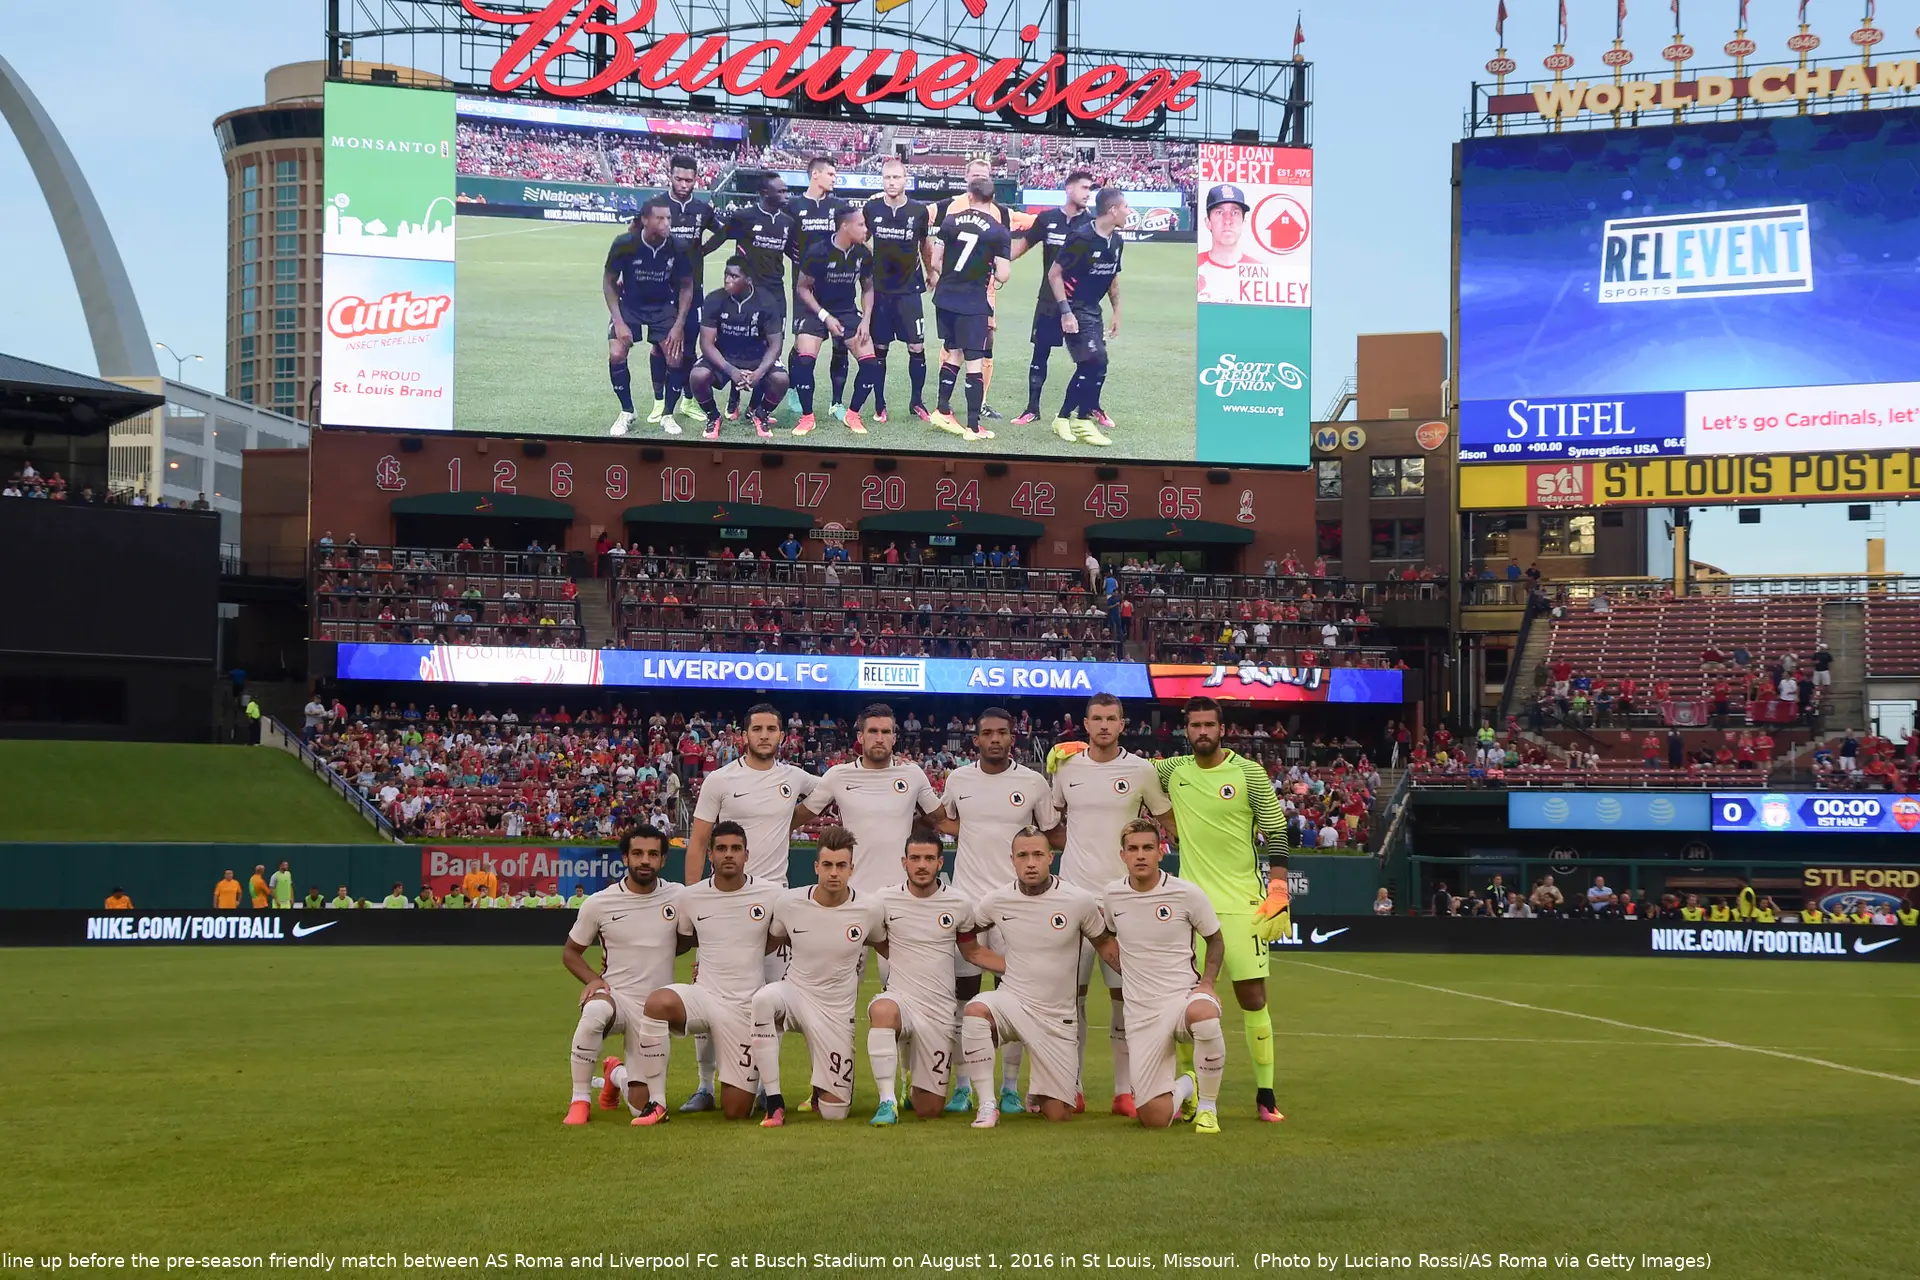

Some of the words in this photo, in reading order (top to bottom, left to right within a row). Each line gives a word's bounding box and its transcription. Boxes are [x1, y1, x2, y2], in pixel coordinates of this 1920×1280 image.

[1604, 51, 1632, 64] 1934
[1663, 46, 1692, 59] 1942
[1726, 41, 1755, 55] 1944
[456, 0, 1202, 123] Budweiser
[1487, 60, 1515, 72] 1926
[1546, 55, 1572, 68] 1931
[1531, 75, 1734, 119] WORLD
[1749, 59, 1919, 103] CHAM
[331, 136, 436, 154] MONSANTO
[1198, 144, 1234, 160] HOME
[1239, 146, 1274, 162] LOAN
[1198, 158, 1274, 184] EXPERT
[918, 179, 940, 190] Mercy
[954, 215, 991, 232] MILNER
[953, 231, 979, 272] 7
[1604, 221, 1804, 283] RELEVENT
[1238, 265, 1269, 279] RYAN
[1239, 280, 1309, 304] KELLEY
[1604, 286, 1672, 298] SPORTS
[328, 293, 450, 337] Cutter
[346, 340, 378, 351] INSECT
[1219, 353, 1275, 373] SCOTT
[357, 369, 366, 379] A
[371, 370, 421, 381] PROUD
[1200, 367, 1270, 386] CREDIT
[333, 382, 352, 393] St.
[357, 383, 394, 396] Louis
[400, 385, 443, 398] Brand
[1215, 379, 1276, 398] UNION
[1222, 404, 1285, 416] www.scu.org
[1507, 399, 1636, 439] STIFEL
[1702, 415, 1747, 431] Let's
[1753, 416, 1779, 432] go
[1785, 409, 1882, 428] Cardinals,
[1419, 427, 1442, 444] gsk
[1493, 443, 1522, 453] 00.00
[1527, 442, 1563, 452] +00.00
[1568, 445, 1632, 459] Synergetics
[1634, 444, 1659, 454] USA
[448, 457, 461, 493] 1
[493, 460, 517, 496] 2
[550, 462, 573, 498] 6
[605, 464, 628, 500] 9
[661, 467, 696, 503] 10
[1536, 465, 1584, 496] stl
[1605, 461, 1654, 498] ST.
[1665, 454, 1772, 496] LOUIS
[727, 469, 762, 505] 14
[794, 472, 831, 508] 17
[861, 475, 906, 511] 20
[935, 478, 980, 513] 24
[1010, 481, 1056, 517] 42
[1084, 483, 1129, 519] 45
[1158, 486, 1202, 520] 85
[1537, 495, 1584, 503] today.com
[456, 646, 545, 660] FOOTBALL
[551, 648, 588, 663] CLUB
[643, 658, 789, 682] LIVERPOOL
[796, 663, 828, 683] FC
[863, 666, 920, 683] RELEVENT
[967, 666, 1005, 688] AS
[1012, 667, 1092, 690] ROMA
[1723, 803, 1742, 822] 0
[1813, 799, 1881, 816] 00:00
[1836, 817, 1868, 827] HALF
[502, 852, 529, 877] of
[531, 852, 630, 878] Americ
[1804, 868, 1920, 888] STLFORD
[87, 916, 285, 940] NIKE.COM/FOOTBALL
[1651, 928, 1847, 954] NIKE.COM/FOOTBALL
[777, 945, 788, 963] 4
[739, 1043, 751, 1068] 3
[829, 1051, 853, 1083] 92
